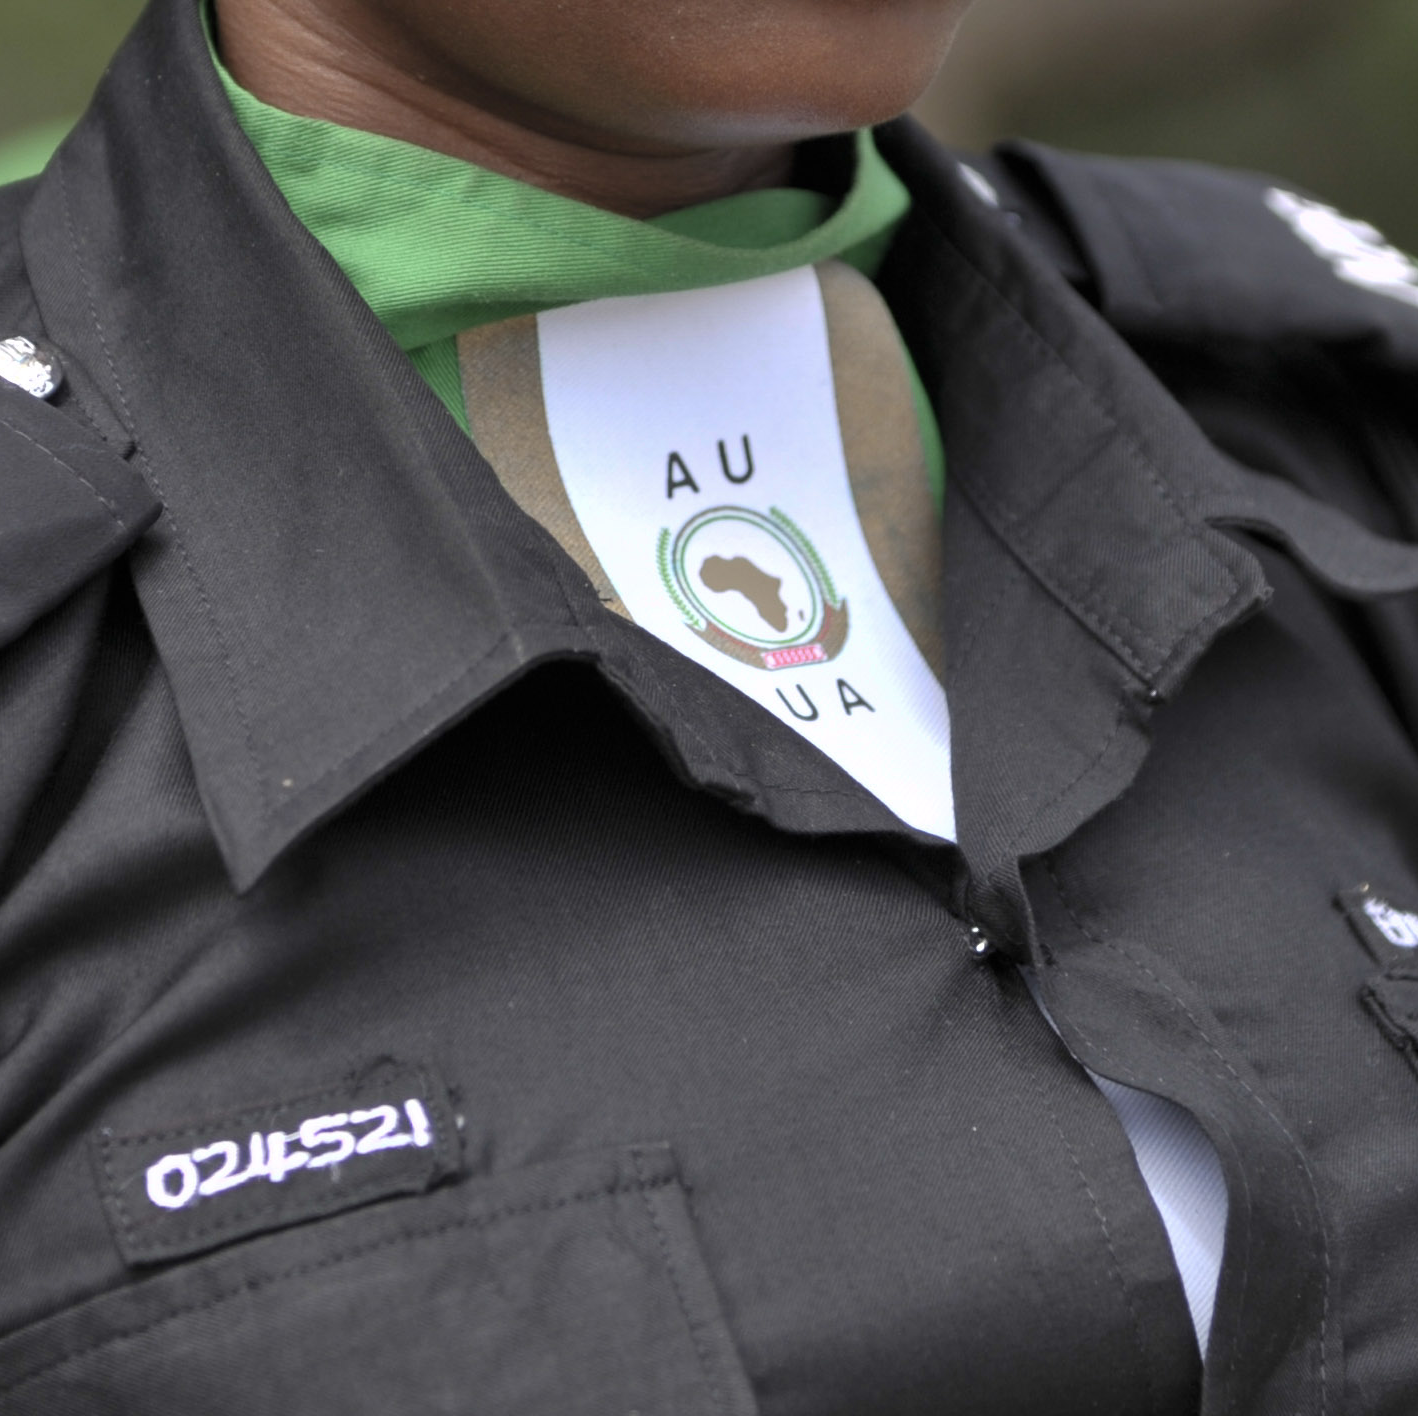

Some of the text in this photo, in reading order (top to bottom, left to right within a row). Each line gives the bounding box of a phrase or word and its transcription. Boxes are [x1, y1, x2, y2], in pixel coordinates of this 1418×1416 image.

[666, 433, 756, 500] AU
[774, 677, 876, 723] UA
[146, 1097, 431, 1210] 024521
